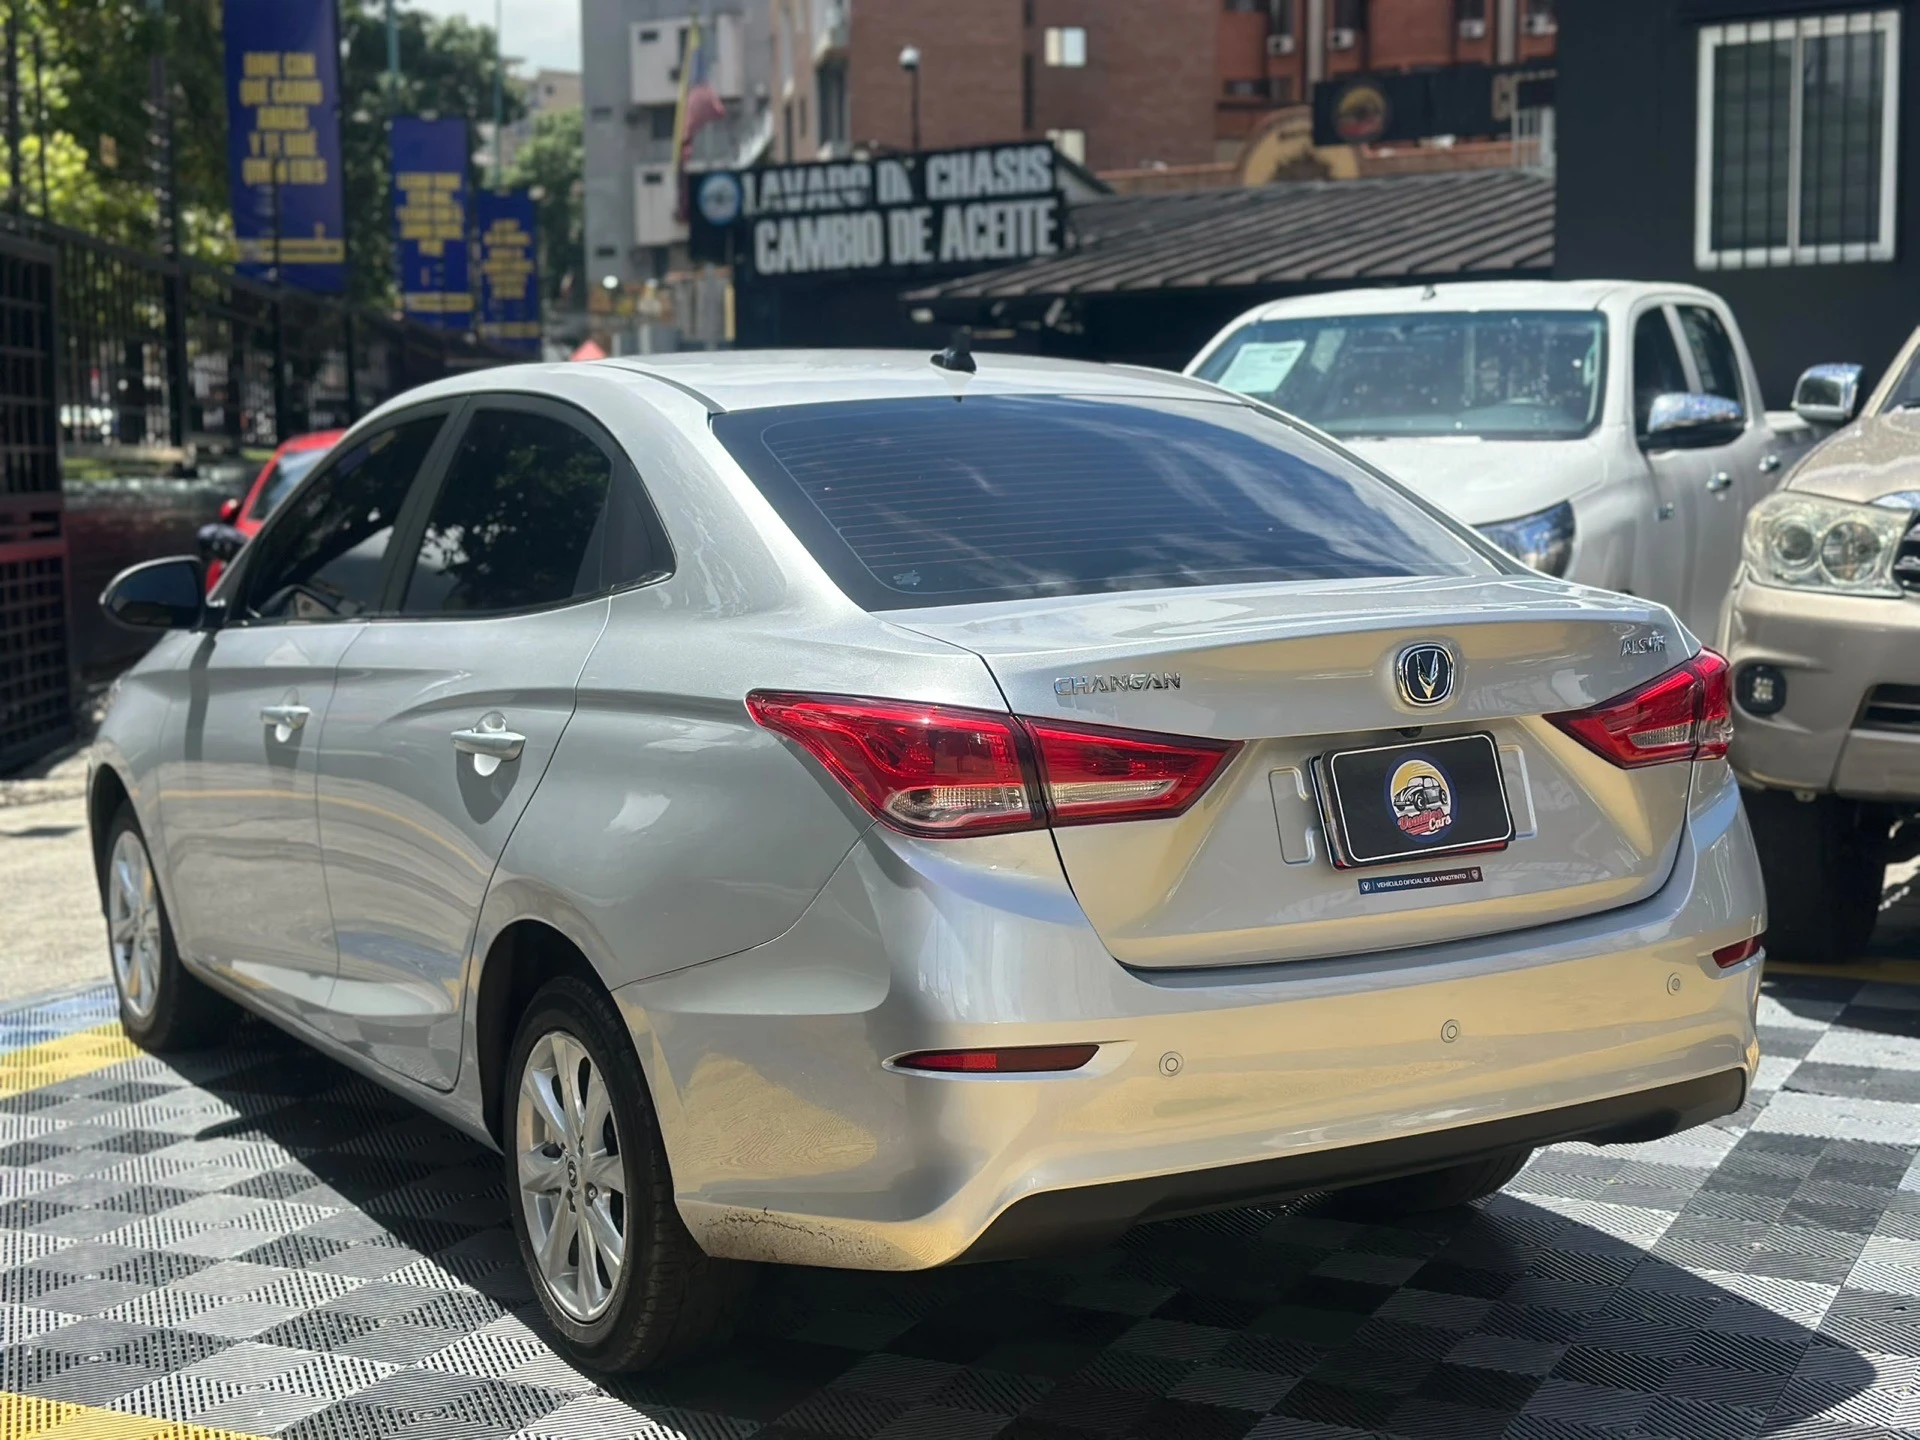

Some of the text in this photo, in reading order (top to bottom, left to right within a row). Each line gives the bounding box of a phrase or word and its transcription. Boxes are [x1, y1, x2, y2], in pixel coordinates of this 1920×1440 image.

[926, 146, 1052, 200] CHASIS
[755, 198, 1058, 275] CAMBIO DE ACEITE
[1053, 672, 1181, 696] CHANGAN
[1428, 815, 1452, 831] Cars
